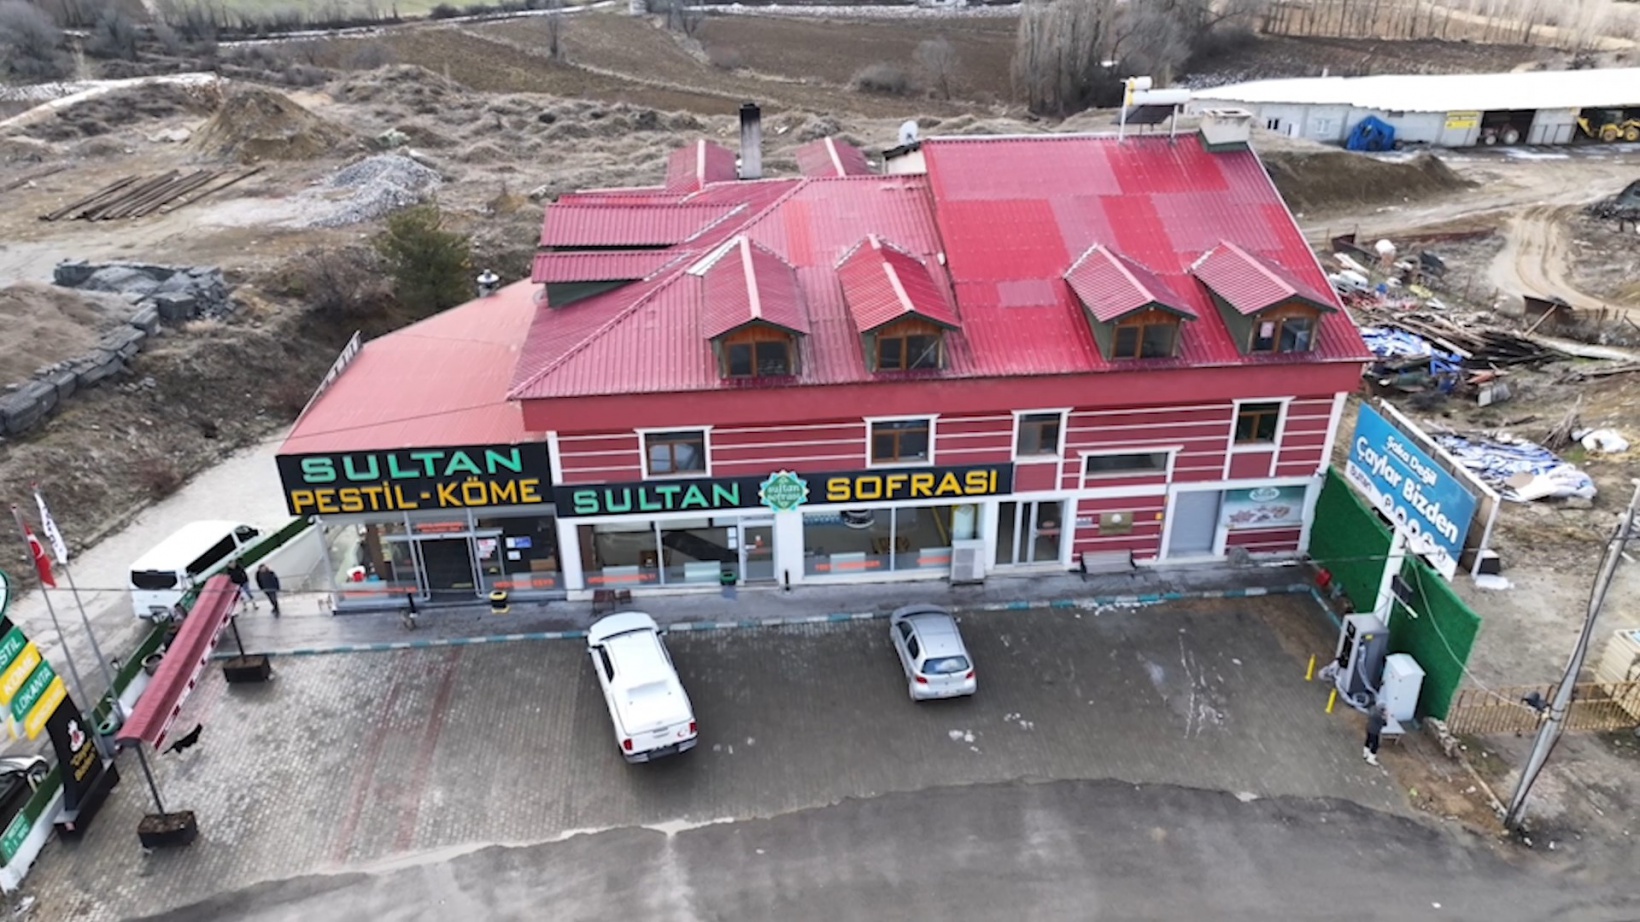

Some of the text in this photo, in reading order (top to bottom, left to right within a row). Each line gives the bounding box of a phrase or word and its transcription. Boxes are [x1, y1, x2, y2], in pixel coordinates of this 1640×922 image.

[301, 448, 523, 483] SULTAN
[1386, 435, 1438, 486] Şaka Değil
[291, 480, 418, 514] PESTİL
[436, 477, 542, 507] KÖME
[573, 470, 998, 514] SULTAN SOFRASI
[1356, 436, 1402, 487] Çaylar
[1402, 477, 1459, 545] Bizden
[15, 666, 53, 715] LOKANTA
